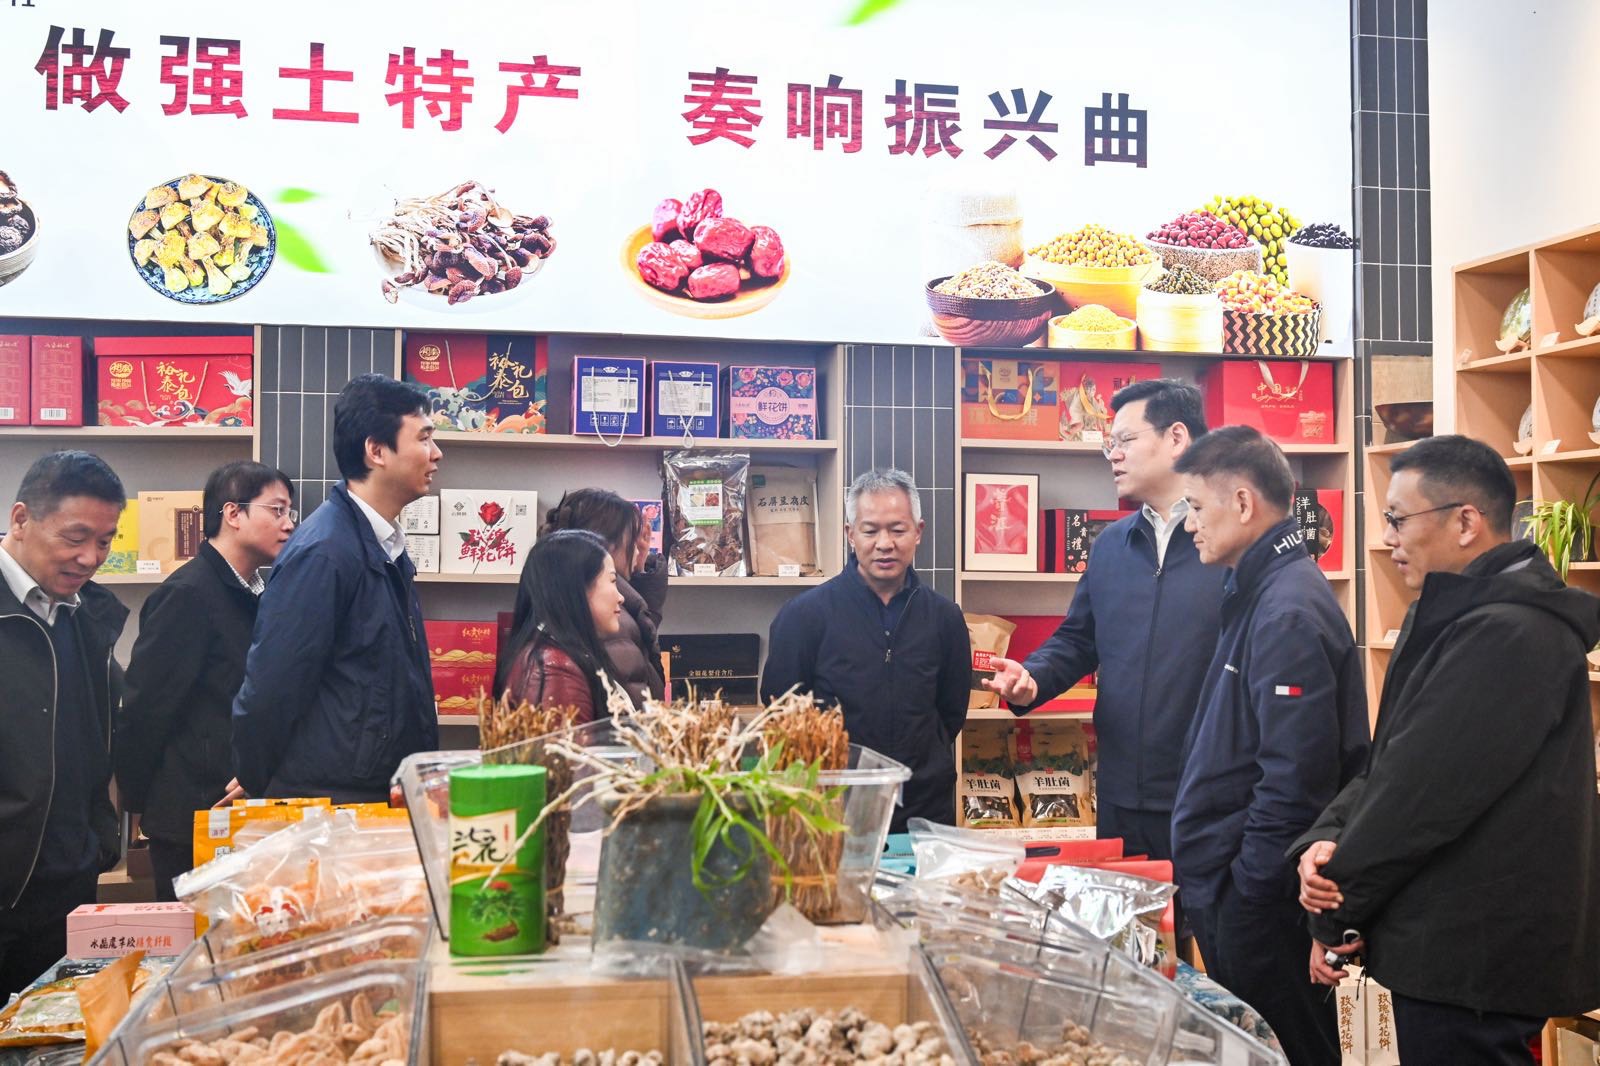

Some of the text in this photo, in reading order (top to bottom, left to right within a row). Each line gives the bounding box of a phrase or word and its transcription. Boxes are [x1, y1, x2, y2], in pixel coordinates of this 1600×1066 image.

[35, 24, 1149, 169] 做强土特产 奏响振兴曲
[757, 402, 788, 413] 鲜花饼
[758, 495, 809, 507] 石屏豆腐皮
[1300, 496, 1318, 541] 羊肚菌
[458, 542, 517, 566] 鲜花饼
[966, 778, 1001, 791] 羊肚菌
[1034, 776, 1070, 788] 羊肚菌
